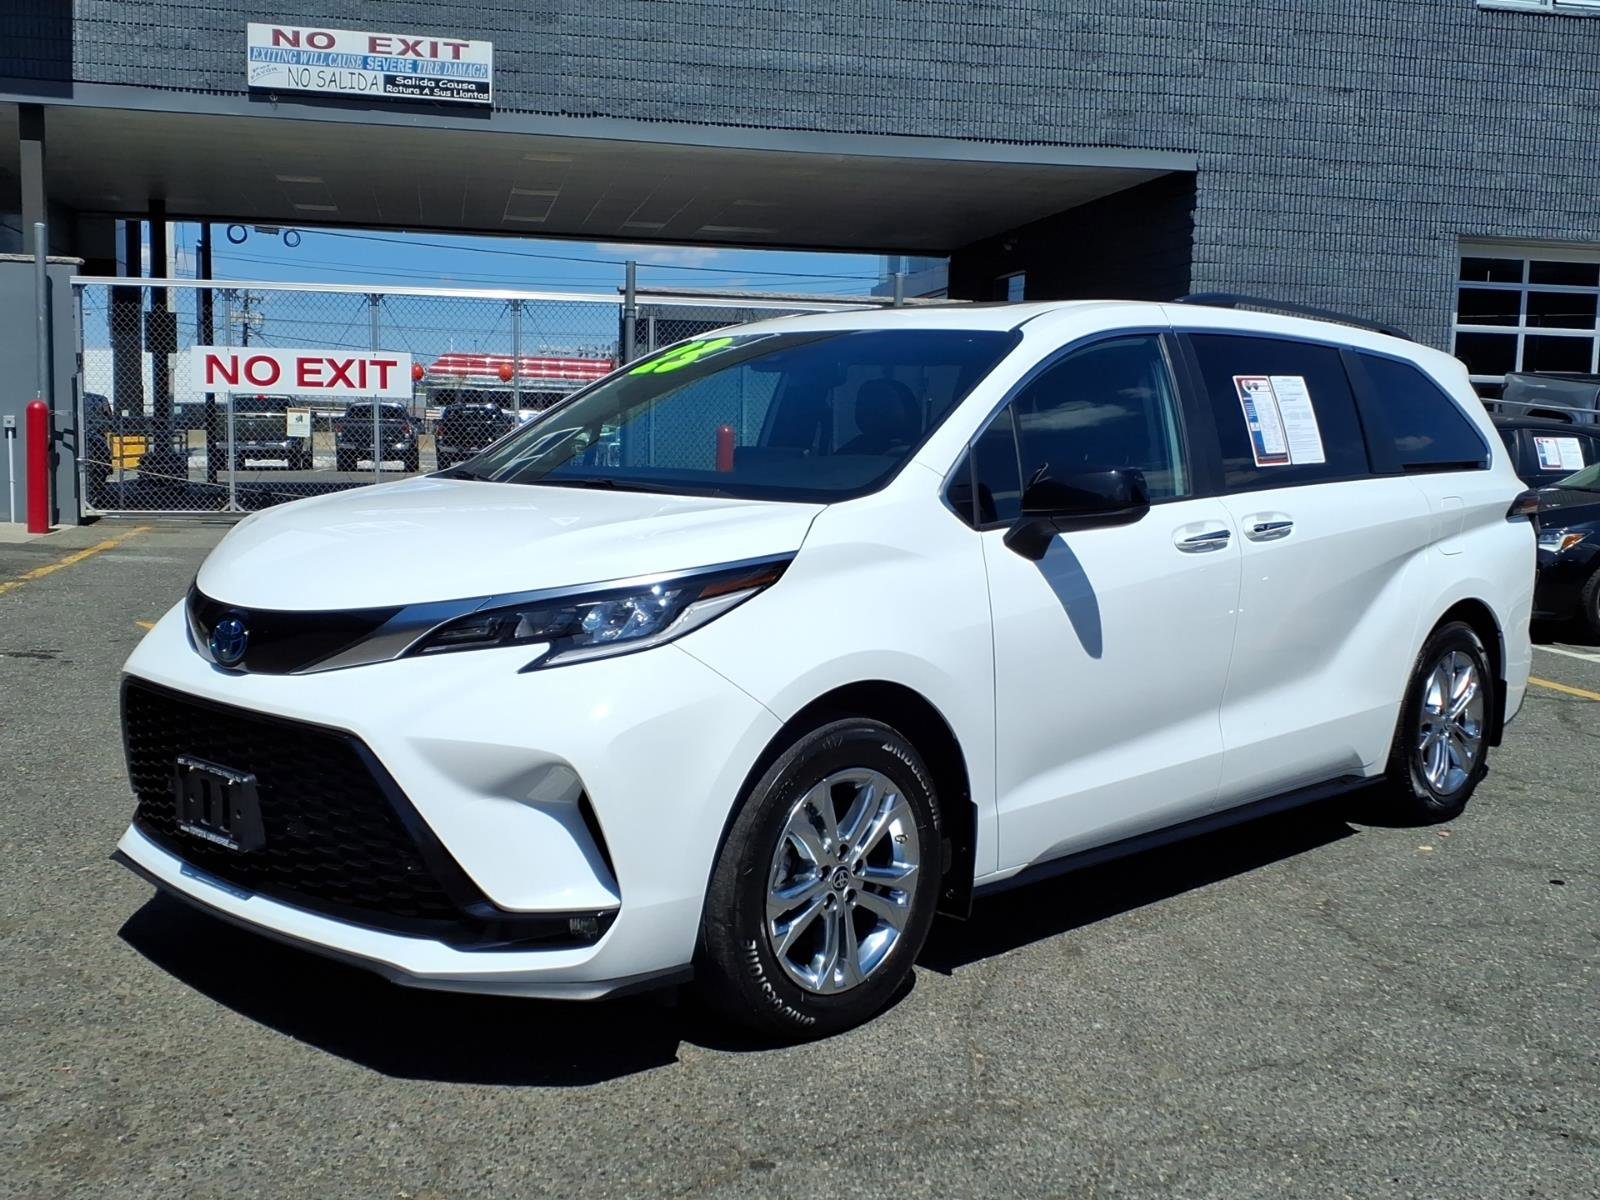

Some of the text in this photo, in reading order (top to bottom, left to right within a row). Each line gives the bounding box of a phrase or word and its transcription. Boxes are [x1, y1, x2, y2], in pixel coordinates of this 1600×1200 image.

[271, 28, 470, 60] NO EXIT
[251, 47, 488, 78] EXITING WILL CAUSE SEVERE TIRE DAMAGE
[287, 66, 379, 92] NO SALIDA
[385, 84, 489, 100] Rotura A Sus Llantas
[394, 76, 476, 90] Salida Causa
[205, 354, 398, 390] NO EXIT
